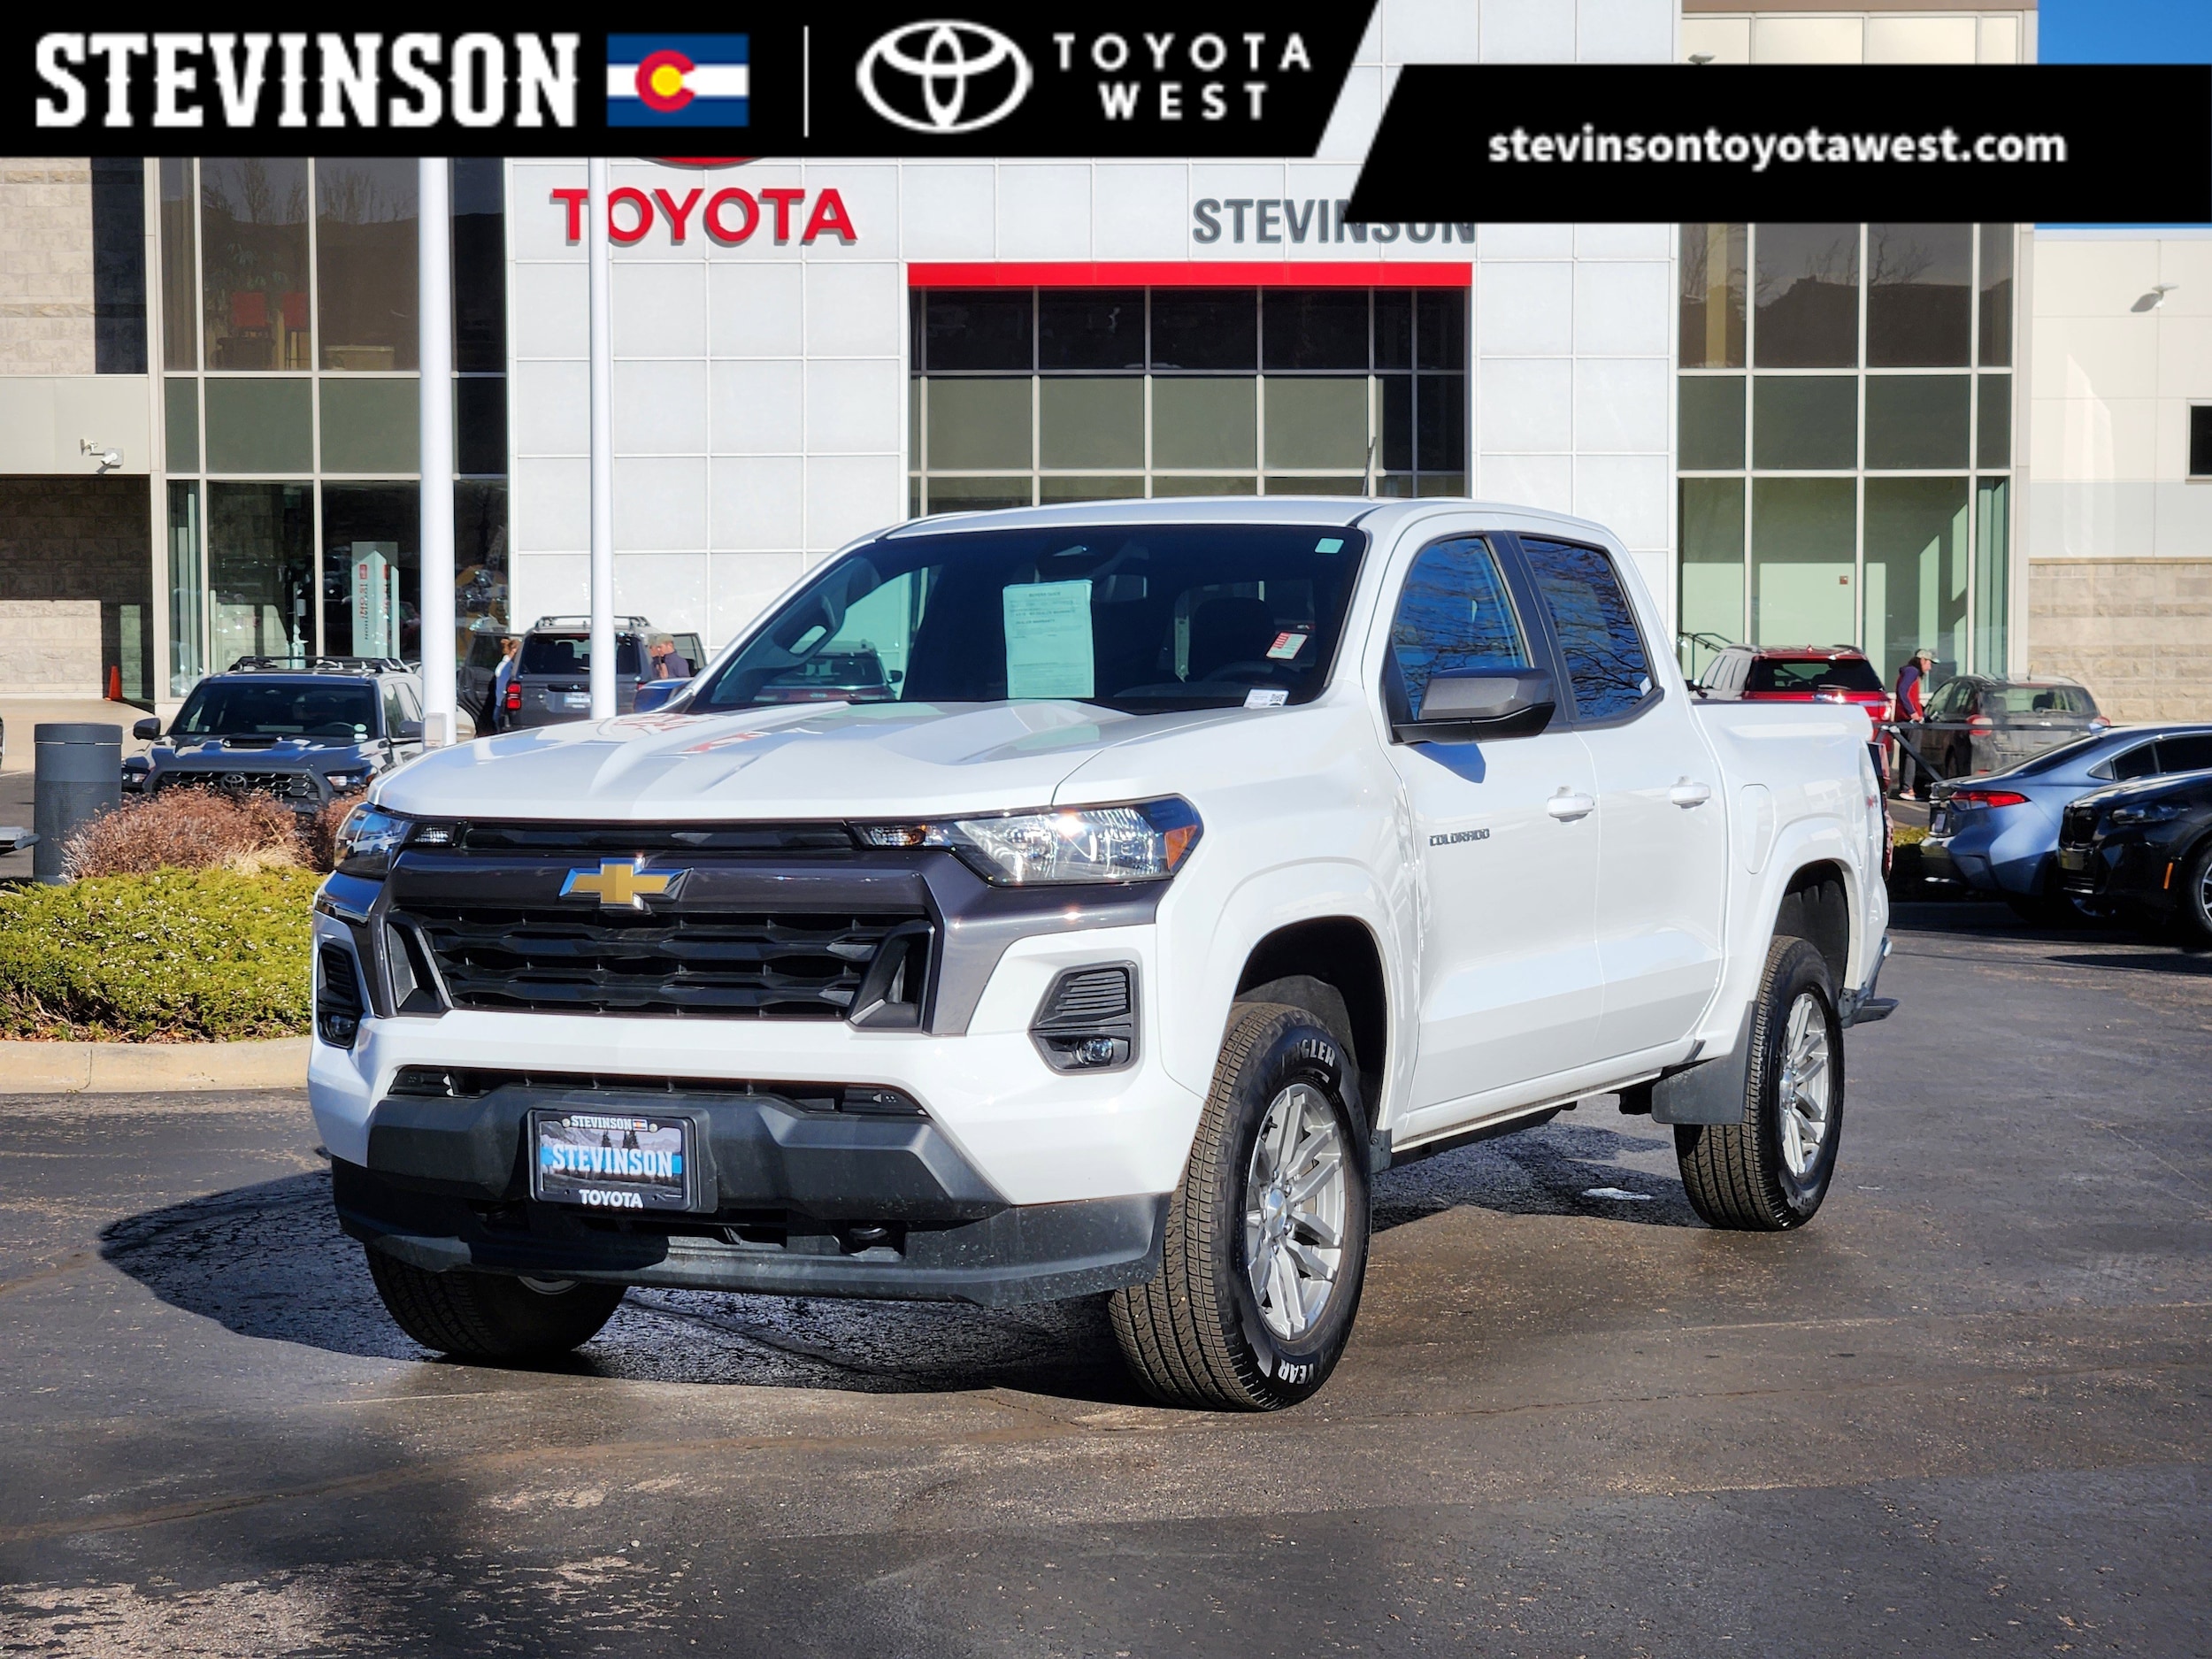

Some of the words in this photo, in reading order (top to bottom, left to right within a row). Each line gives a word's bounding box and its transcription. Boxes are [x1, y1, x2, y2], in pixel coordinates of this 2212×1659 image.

[551, 187, 858, 244] TOYOTA
[570, 1115, 634, 1131] STEVINSON
[552, 1144, 673, 1178] STEVINSON
[579, 1189, 644, 1209] TOYOTA
